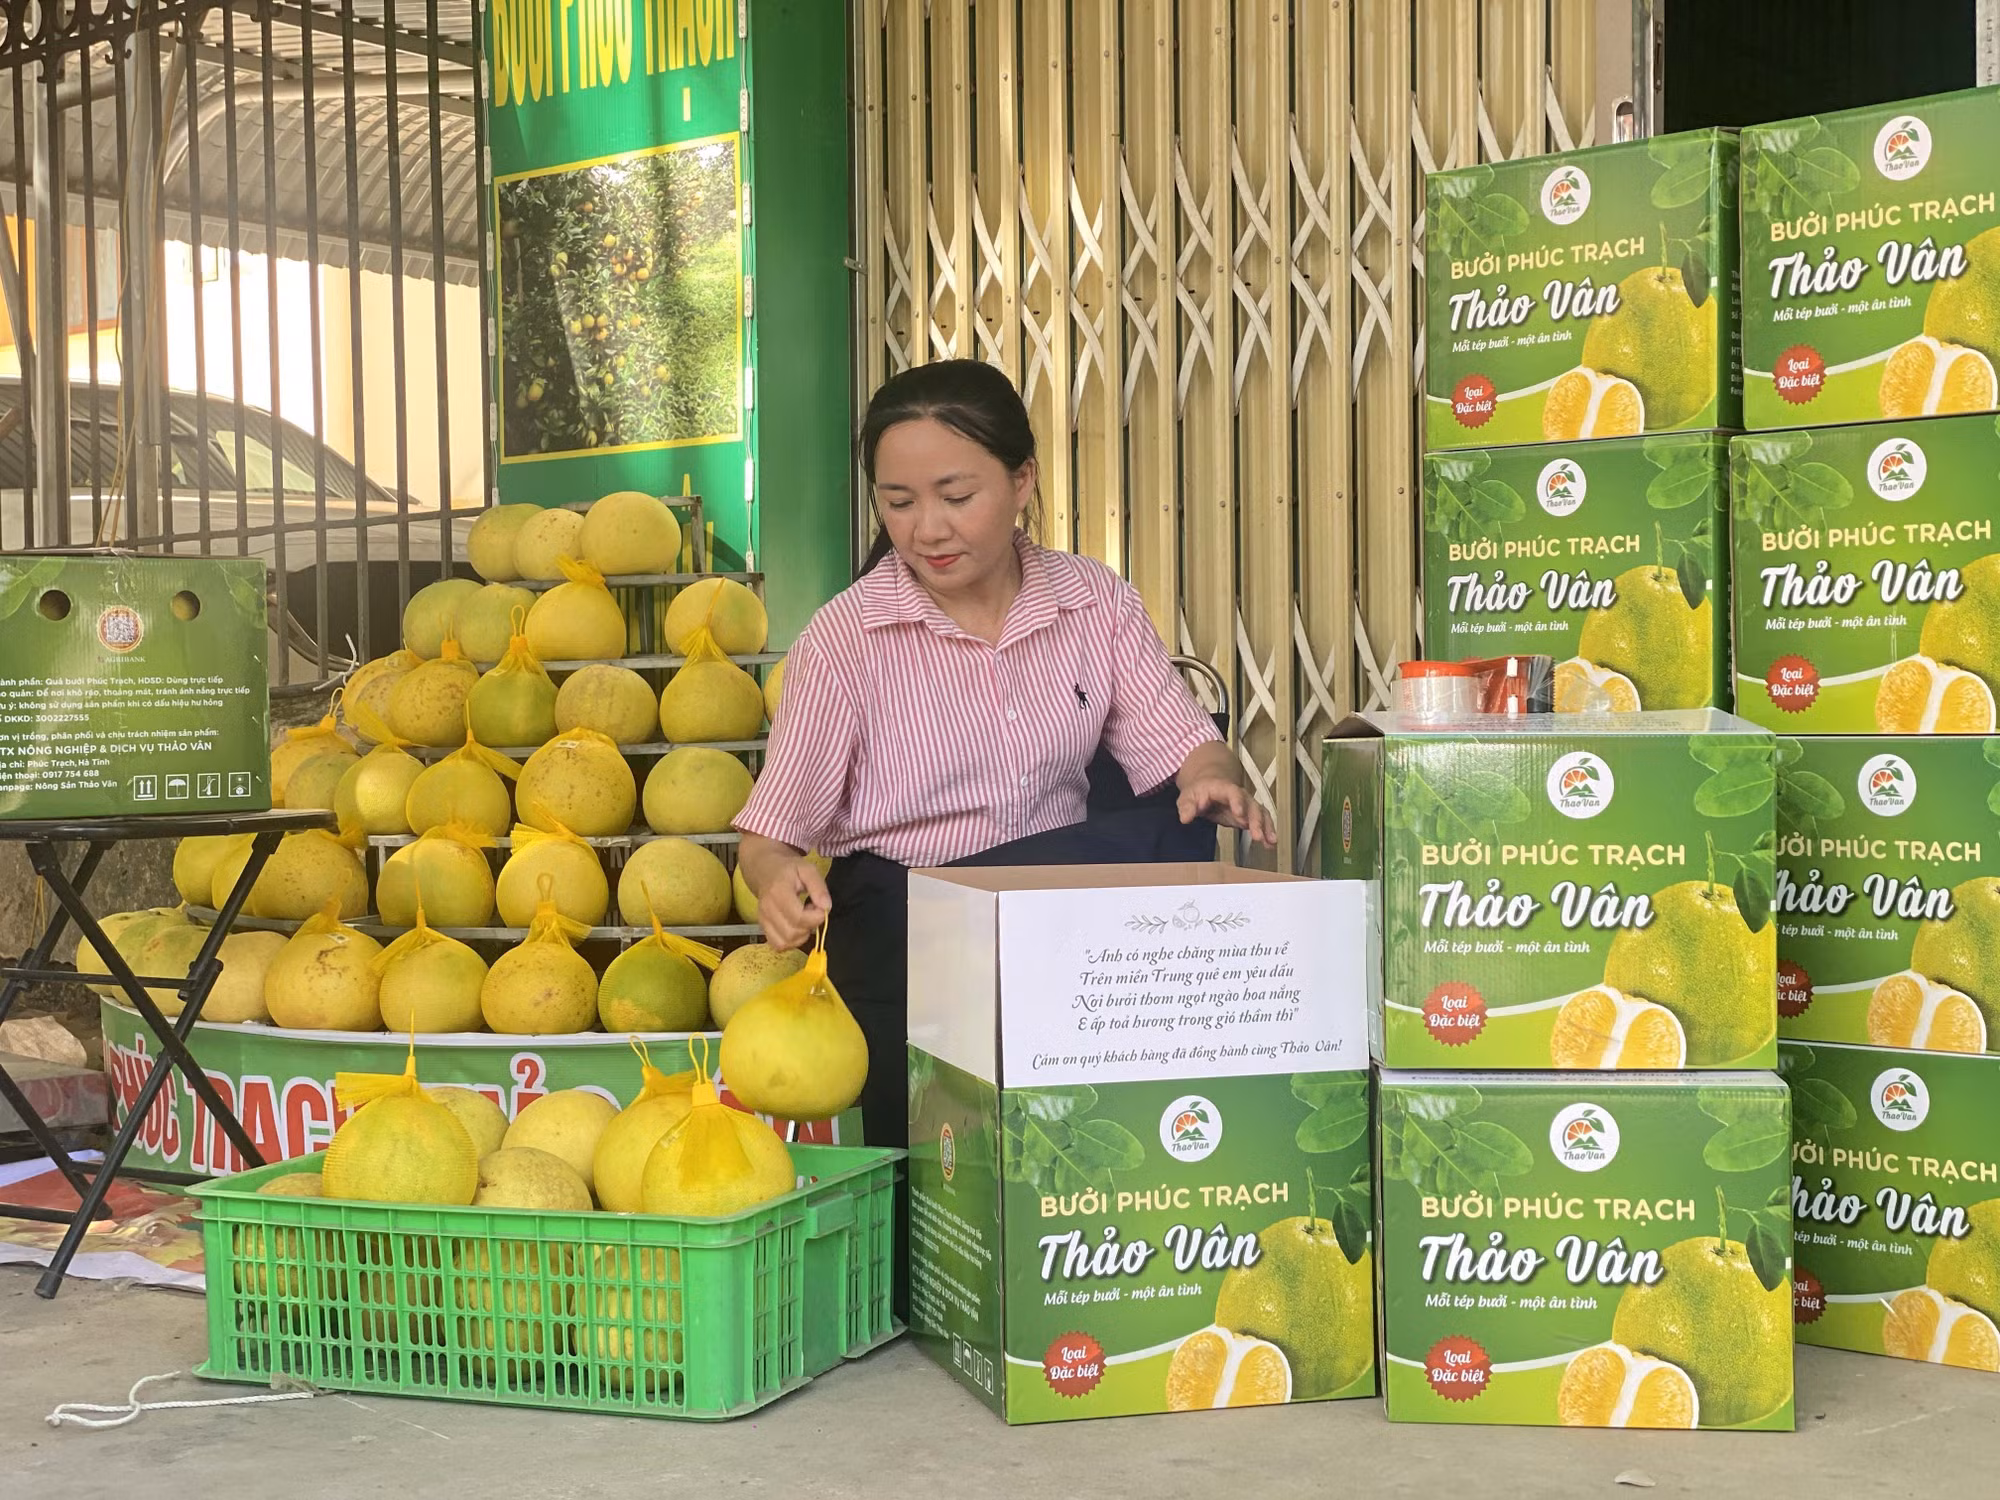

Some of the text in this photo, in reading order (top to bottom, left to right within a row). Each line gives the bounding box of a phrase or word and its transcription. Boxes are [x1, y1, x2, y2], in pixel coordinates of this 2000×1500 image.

[1770, 192, 1995, 241] BƯỞI PHÚC TRẠCH
[1450, 236, 1644, 280] BƯỞI PHÚC TRẠCH
[1768, 237, 1968, 299] Thảo Vân
[1449, 277, 1620, 331] Thảo Vân
[1449, 534, 1640, 561] BƯỞI PHÚC TRẠCH
[1762, 520, 1991, 551] BƯỞI PHÚC TRẠCH
[1447, 568, 1617, 613] Thảo Vân
[1760, 559, 1964, 608] Thảo Vân
[87, 677, 108, 685] Phúc
[166, 676, 188, 686] Dùng
[190, 677, 206, 685] trực
[208, 675, 223, 684] tiếp
[1780, 667, 1802, 680] Loại
[36, 714, 89, 722] 3002227555
[18, 745, 52, 755] NÔNG
[55, 743, 96, 756] NGHIỆP
[100, 745, 107, 753] &
[110, 745, 136, 755] DỊCH
[140, 744, 154, 754] VỤ
[158, 740, 187, 751] THẢO
[191, 740, 212, 751] VÂN
[51, 760, 77, 768] Trạch,
[35, 782, 58, 790] Nông
[102, 780, 117, 788] Vân
[1422, 838, 1686, 872] BƯỞI PHÚC TRẠCH
[1776, 832, 1980, 866] ƯỞI PHÚC TRẠCH
[1419, 879, 1654, 929] Thảo Vân
[1776, 869, 1954, 919] hảo Vân
[1127, 949, 1138, 961] có
[1142, 947, 1174, 965] nghe
[1177, 946, 1215, 963] chăng
[1219, 944, 1247, 957] mùa
[1250, 943, 1272, 957] thu
[1275, 941, 1290, 955] về
[1423, 938, 1590, 956] Mỗi tép bưởi một ân tình
[1080, 963, 1294, 986] Trên miền Trung quê em yêu dấu
[1072, 984, 1301, 1012] Nơi bưởi thơm ngọt ngào hoa nắng
[1441, 995, 1468, 1011] Loại
[1090, 1016, 1105, 1035] ấp
[1133, 1015, 1175, 1032] hương
[1178, 1014, 1213, 1030] trong
[1215, 1011, 1235, 1029] gió
[1239, 1008, 1272, 1023] thầm
[1429, 1012, 1481, 1028] Đặc biệt
[1063, 1056, 1077, 1064] ơn
[1080, 1054, 1101, 1068] quý
[1103, 1050, 1137, 1063] khách
[1140, 1049, 1169, 1064] hàng
[1172, 1047, 1186, 1059] đã
[1189, 1045, 1217, 1062] đồng
[1220, 1044, 1248, 1057] hành
[1251, 1044, 1277, 1059] cùng
[1280, 1040, 1309, 1054] Thảo
[1315, 1039, 1342, 1052] Vân!
[1833, 1146, 1899, 1174] PHÚC
[1906, 1156, 1998, 1185] TRẠCH
[1040, 1182, 1289, 1218] BƯỞI PHÚC TRẠCH
[1421, 1190, 1695, 1227] BƯỞI PHÚC TRẠCH
[1792, 1175, 1970, 1237] hảo Vân
[1038, 1225, 1155, 1280] Thảo
[1164, 1223, 1261, 1270] Vân
[1419, 1232, 1664, 1284] Thảo Vân
[1044, 1281, 1202, 1307] Mỗi tép bưởi một ân tình
[1425, 1292, 1598, 1311] Mỗi tép bưởi một ân tình
[1061, 1345, 1087, 1361] Loại
[1443, 1349, 1471, 1365] Loại
[1050, 1362, 1100, 1381] Đặc biệt
[1432, 1367, 1485, 1384] Đặc biệt
